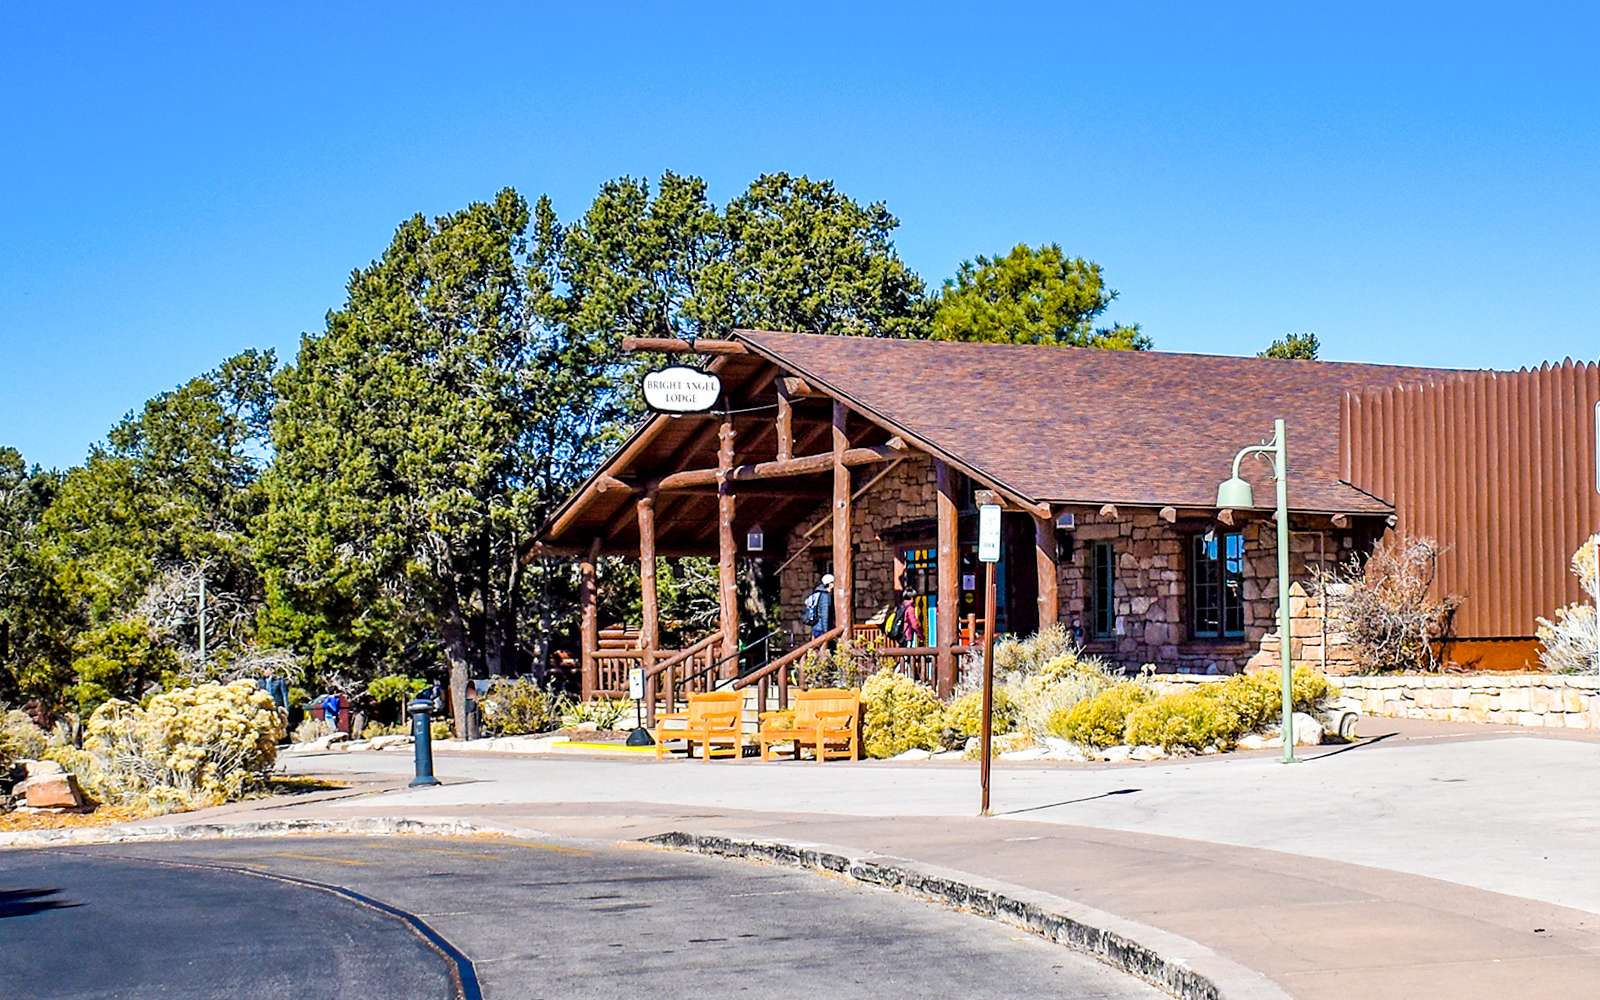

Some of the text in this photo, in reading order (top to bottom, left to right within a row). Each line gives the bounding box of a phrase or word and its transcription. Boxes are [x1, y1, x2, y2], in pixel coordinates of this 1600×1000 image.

[647, 380, 717, 391] BRIGHT ANGEL
[665, 393, 698, 403] LODGE
